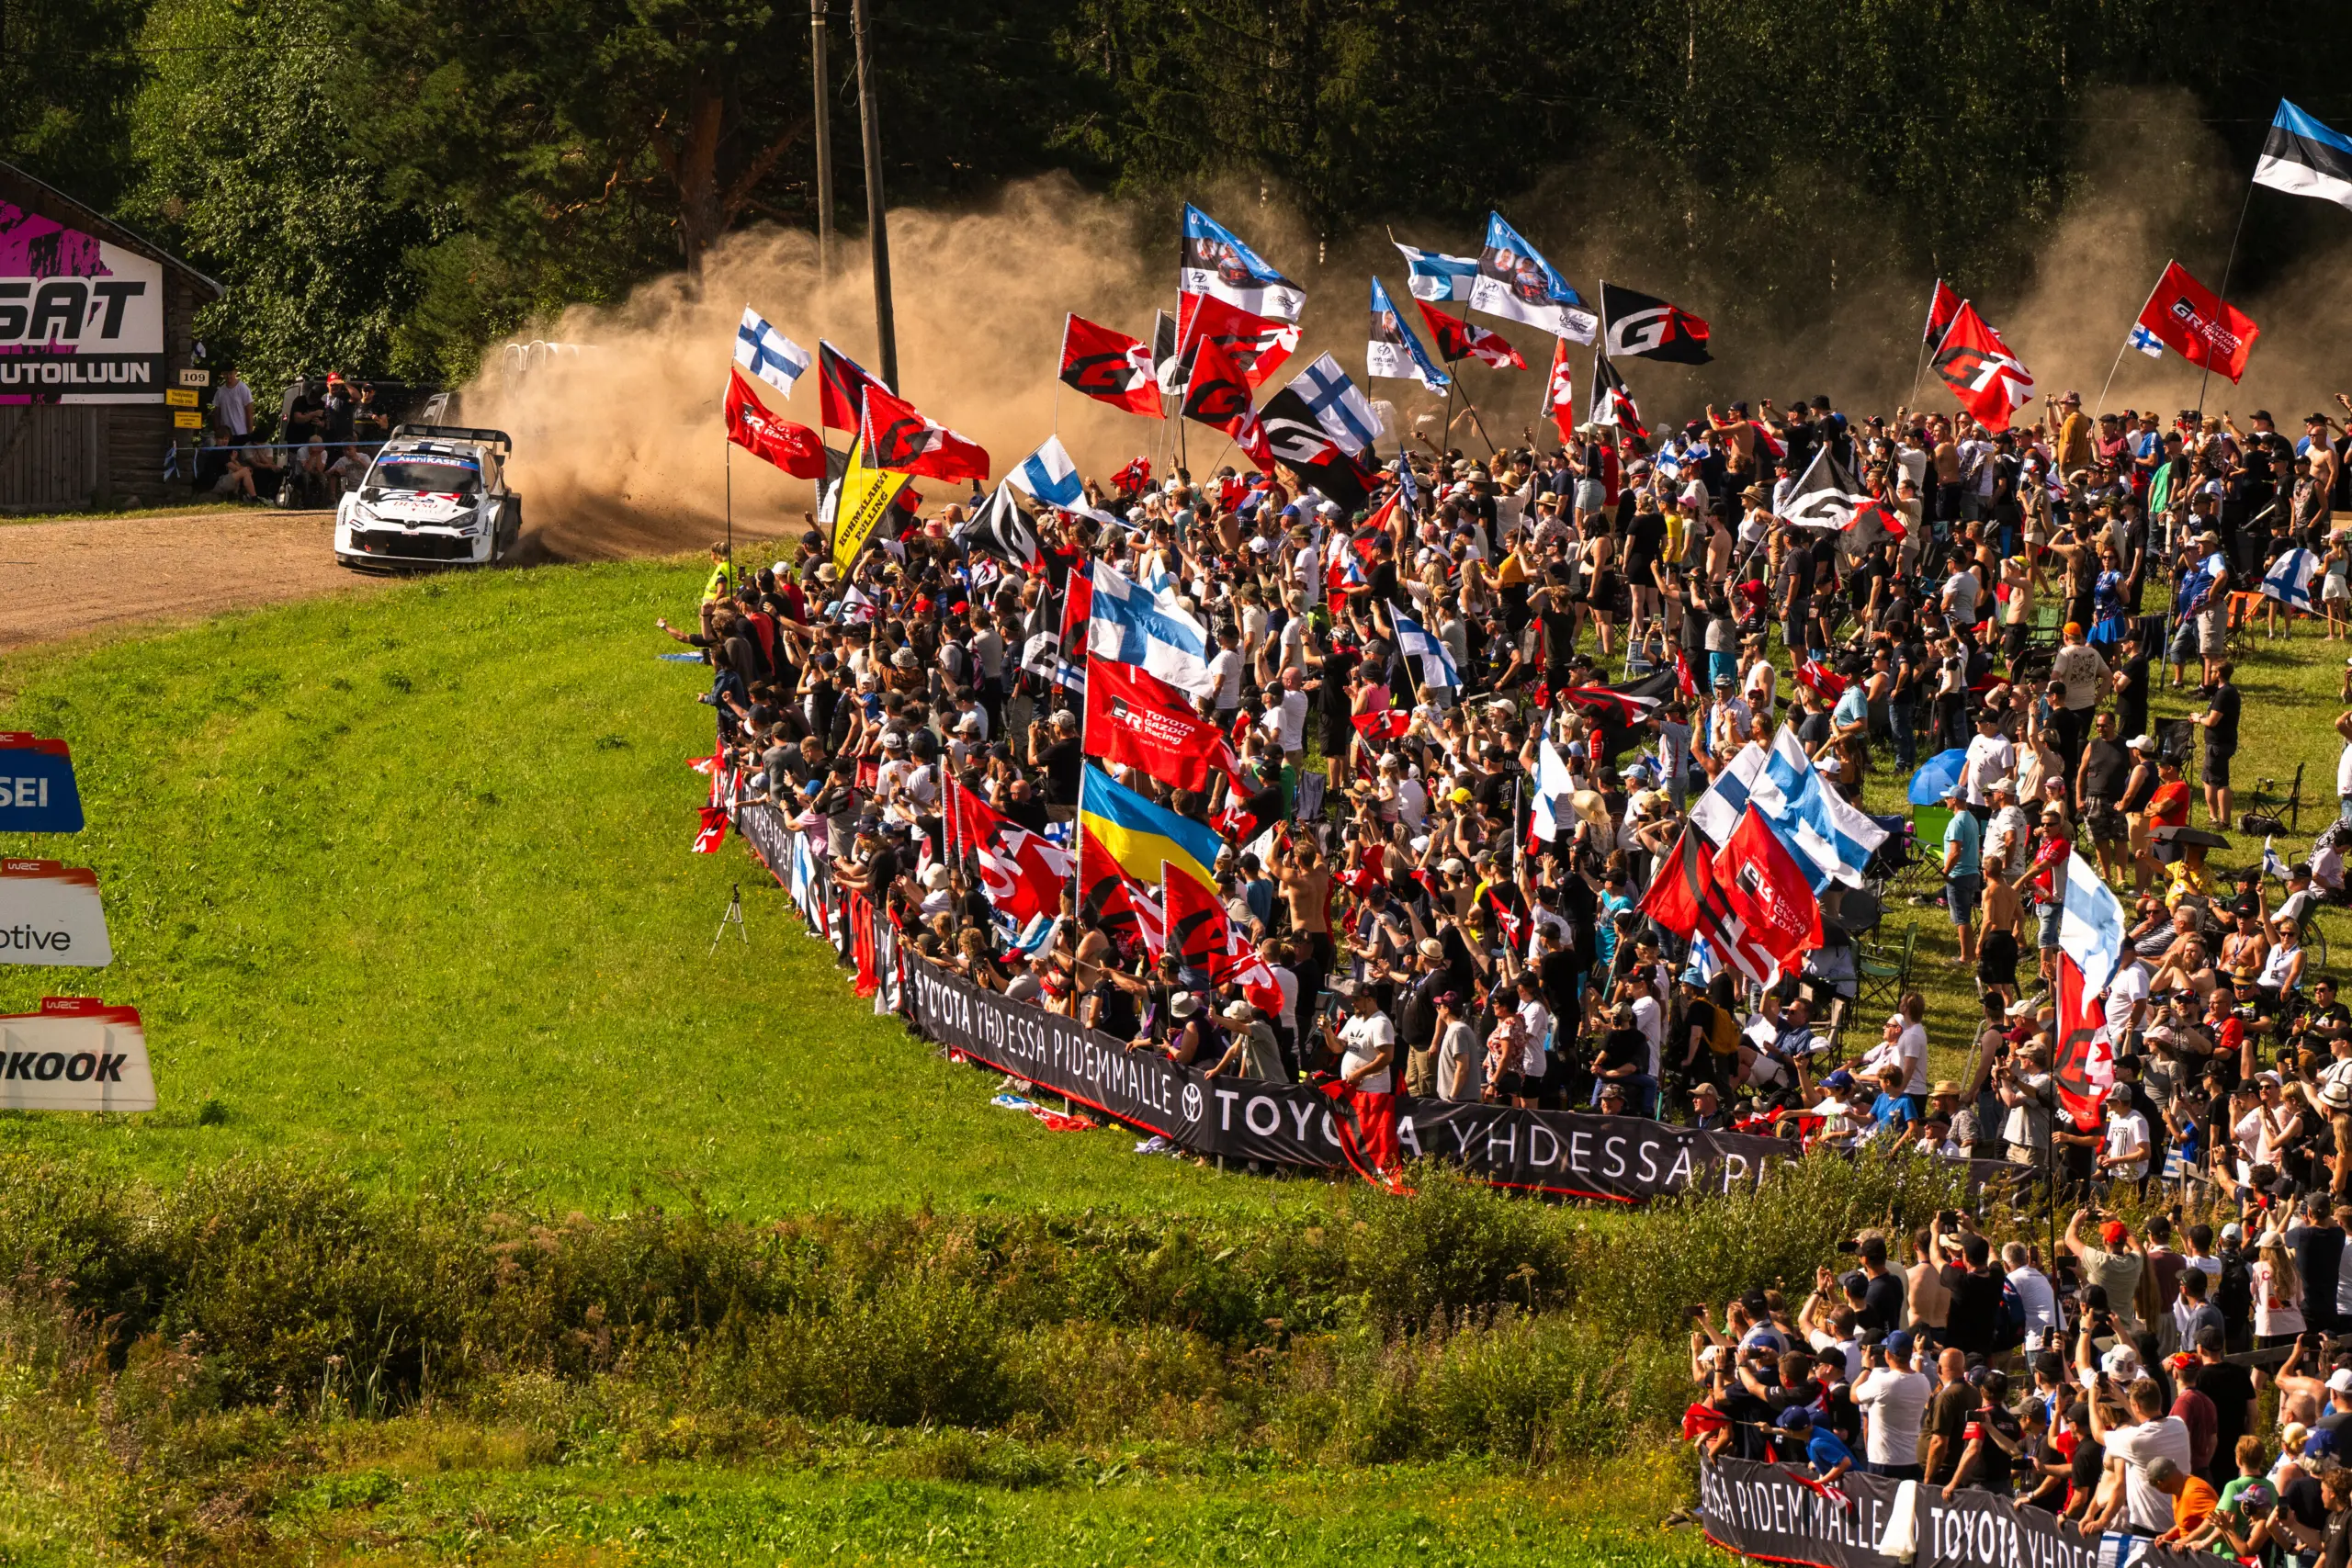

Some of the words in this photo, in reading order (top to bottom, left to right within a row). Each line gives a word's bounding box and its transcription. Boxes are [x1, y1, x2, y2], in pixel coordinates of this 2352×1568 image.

[2172, 303, 2203, 329] GR
[2211, 320, 2242, 345] TOYOTA
[184, 373, 206, 382] 109
[427, 457, 460, 467] KASEI
[838, 470, 888, 547] KUHMALAHTI
[854, 491, 888, 542] PULLING
[1144, 718, 1188, 737] GAZOO
[1146, 710, 1195, 732] TOYOTA
[1144, 727, 1182, 745] Racing
[7, 863, 40, 871] WRC
[46, 1000, 80, 1010] WRC
[975, 998, 1046, 1065] YHDESSÄ
[0, 1051, 128, 1082] KOOK
[1448, 1119, 1695, 1188] YHDESSÄ
[1930, 1506, 2021, 1568] TOYOTA
